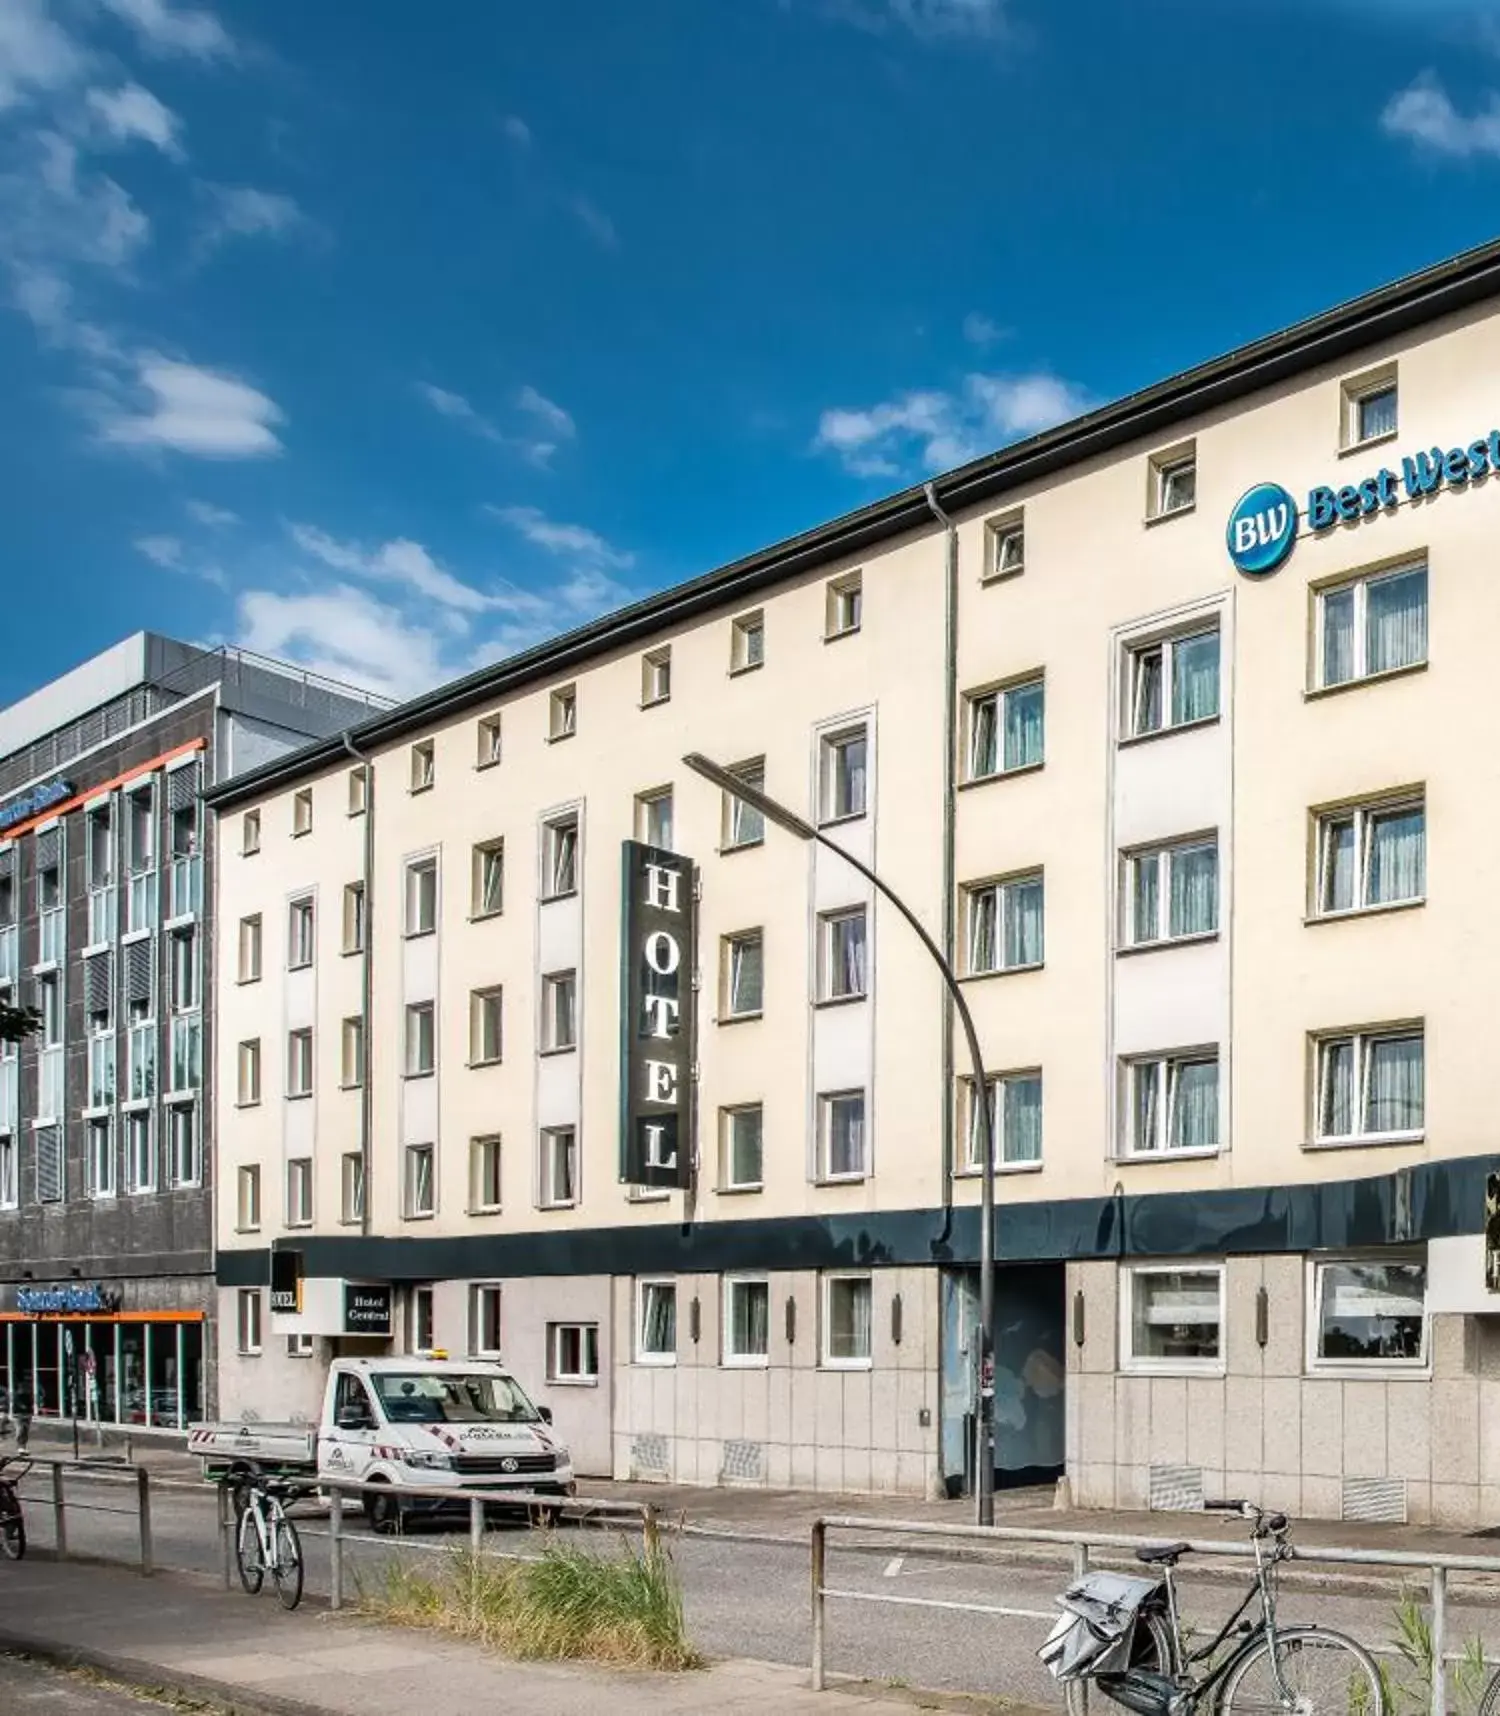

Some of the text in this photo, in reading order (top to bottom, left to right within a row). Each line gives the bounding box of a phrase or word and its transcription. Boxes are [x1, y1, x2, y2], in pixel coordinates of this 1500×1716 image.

[1235, 503, 1287, 554] BW
[1307, 467, 1400, 532] Best
[644, 862, 682, 1169] HOTEL
[347, 1309, 389, 1321] Central
[354, 1296, 385, 1307] Hotel
